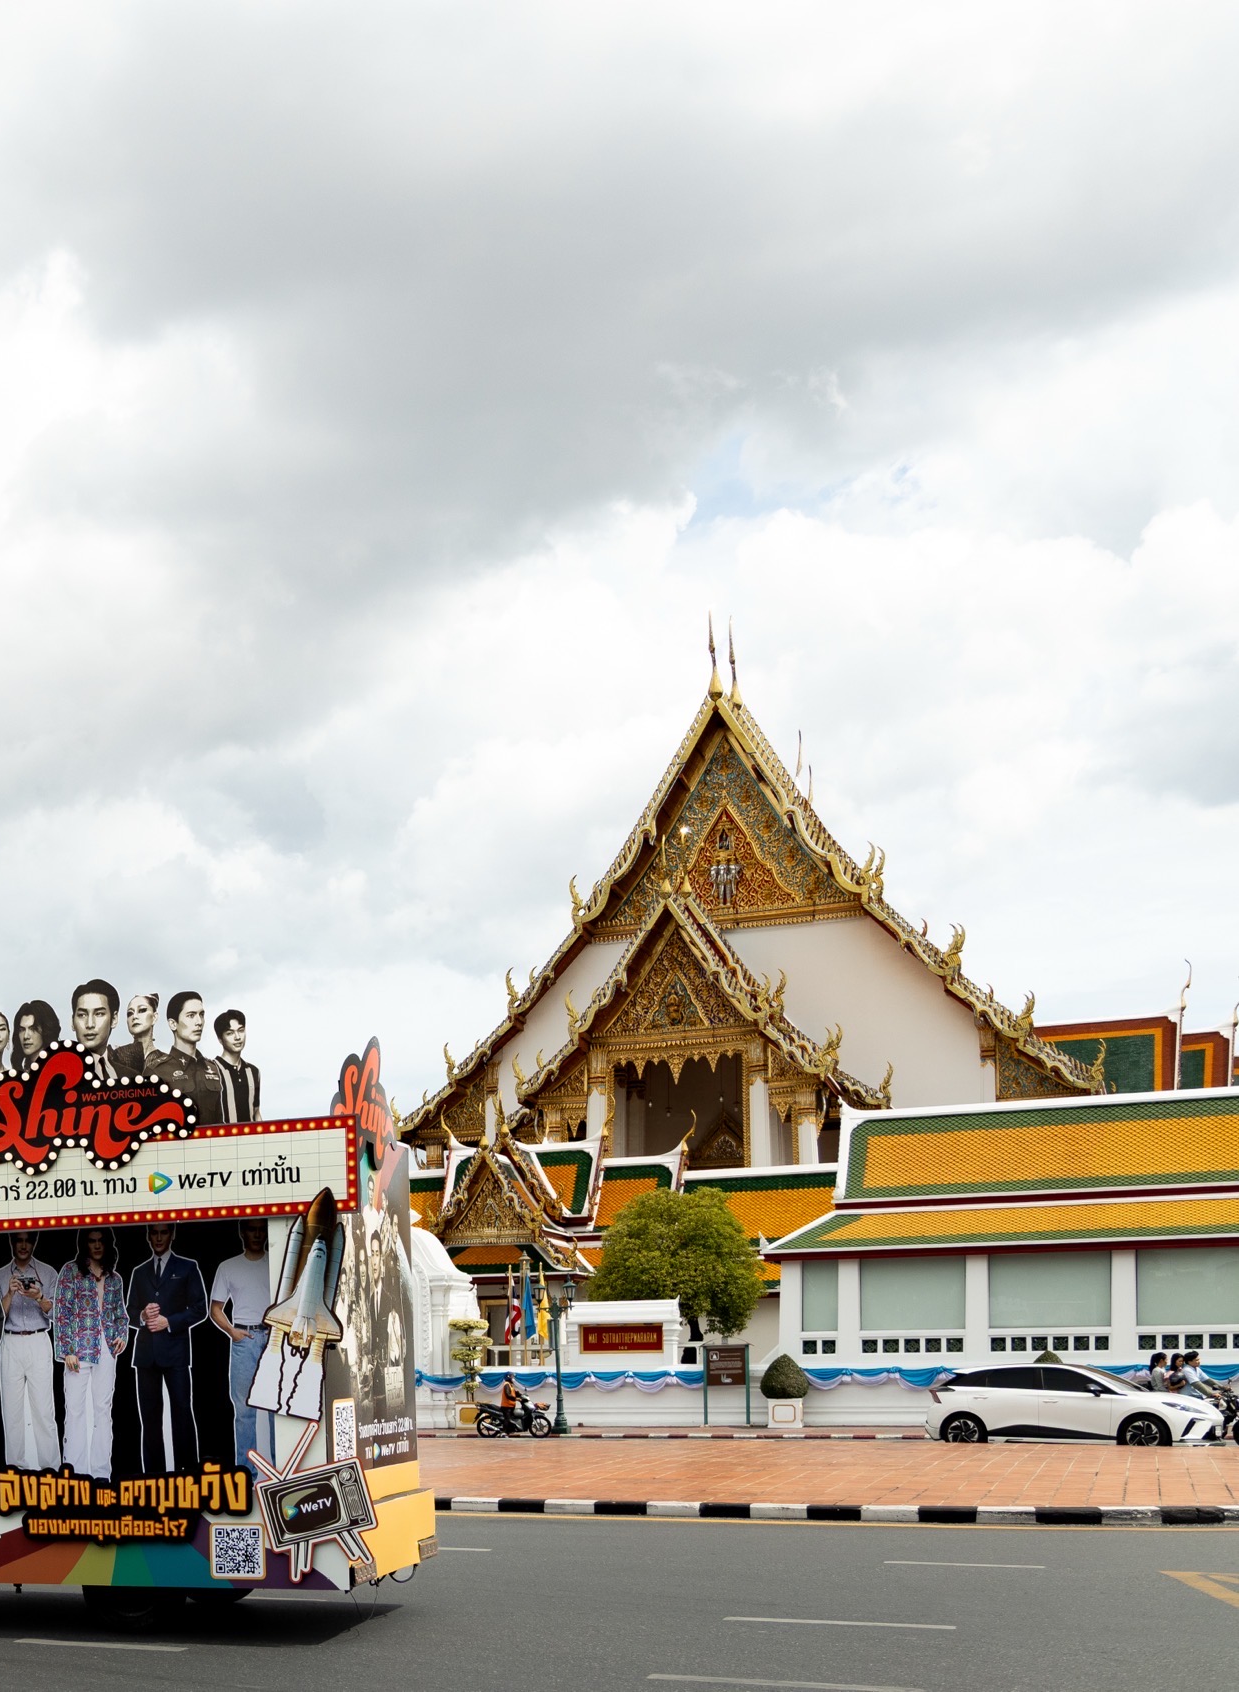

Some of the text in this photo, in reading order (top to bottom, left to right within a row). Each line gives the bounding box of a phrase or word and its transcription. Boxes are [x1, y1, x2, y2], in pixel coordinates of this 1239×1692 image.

[81, 1087, 158, 1102] WeTV ORIGINAL
[25, 1178, 77, 1201] 22.00
[80, 1180, 99, 1196] น.
[103, 1177, 137, 1194] ทาง
[177, 1171, 233, 1190] WeTV
[241, 1155, 301, 1187] เท่านั้น
[381, 1442, 395, 1457] WeTV
[96, 1488, 117, 1507] และ
[120, 1462, 247, 1514] ความหวัง
[300, 1497, 333, 1514] WeTV
[28, 1515, 188, 1541] ของพวกคุณคืออะไร?
